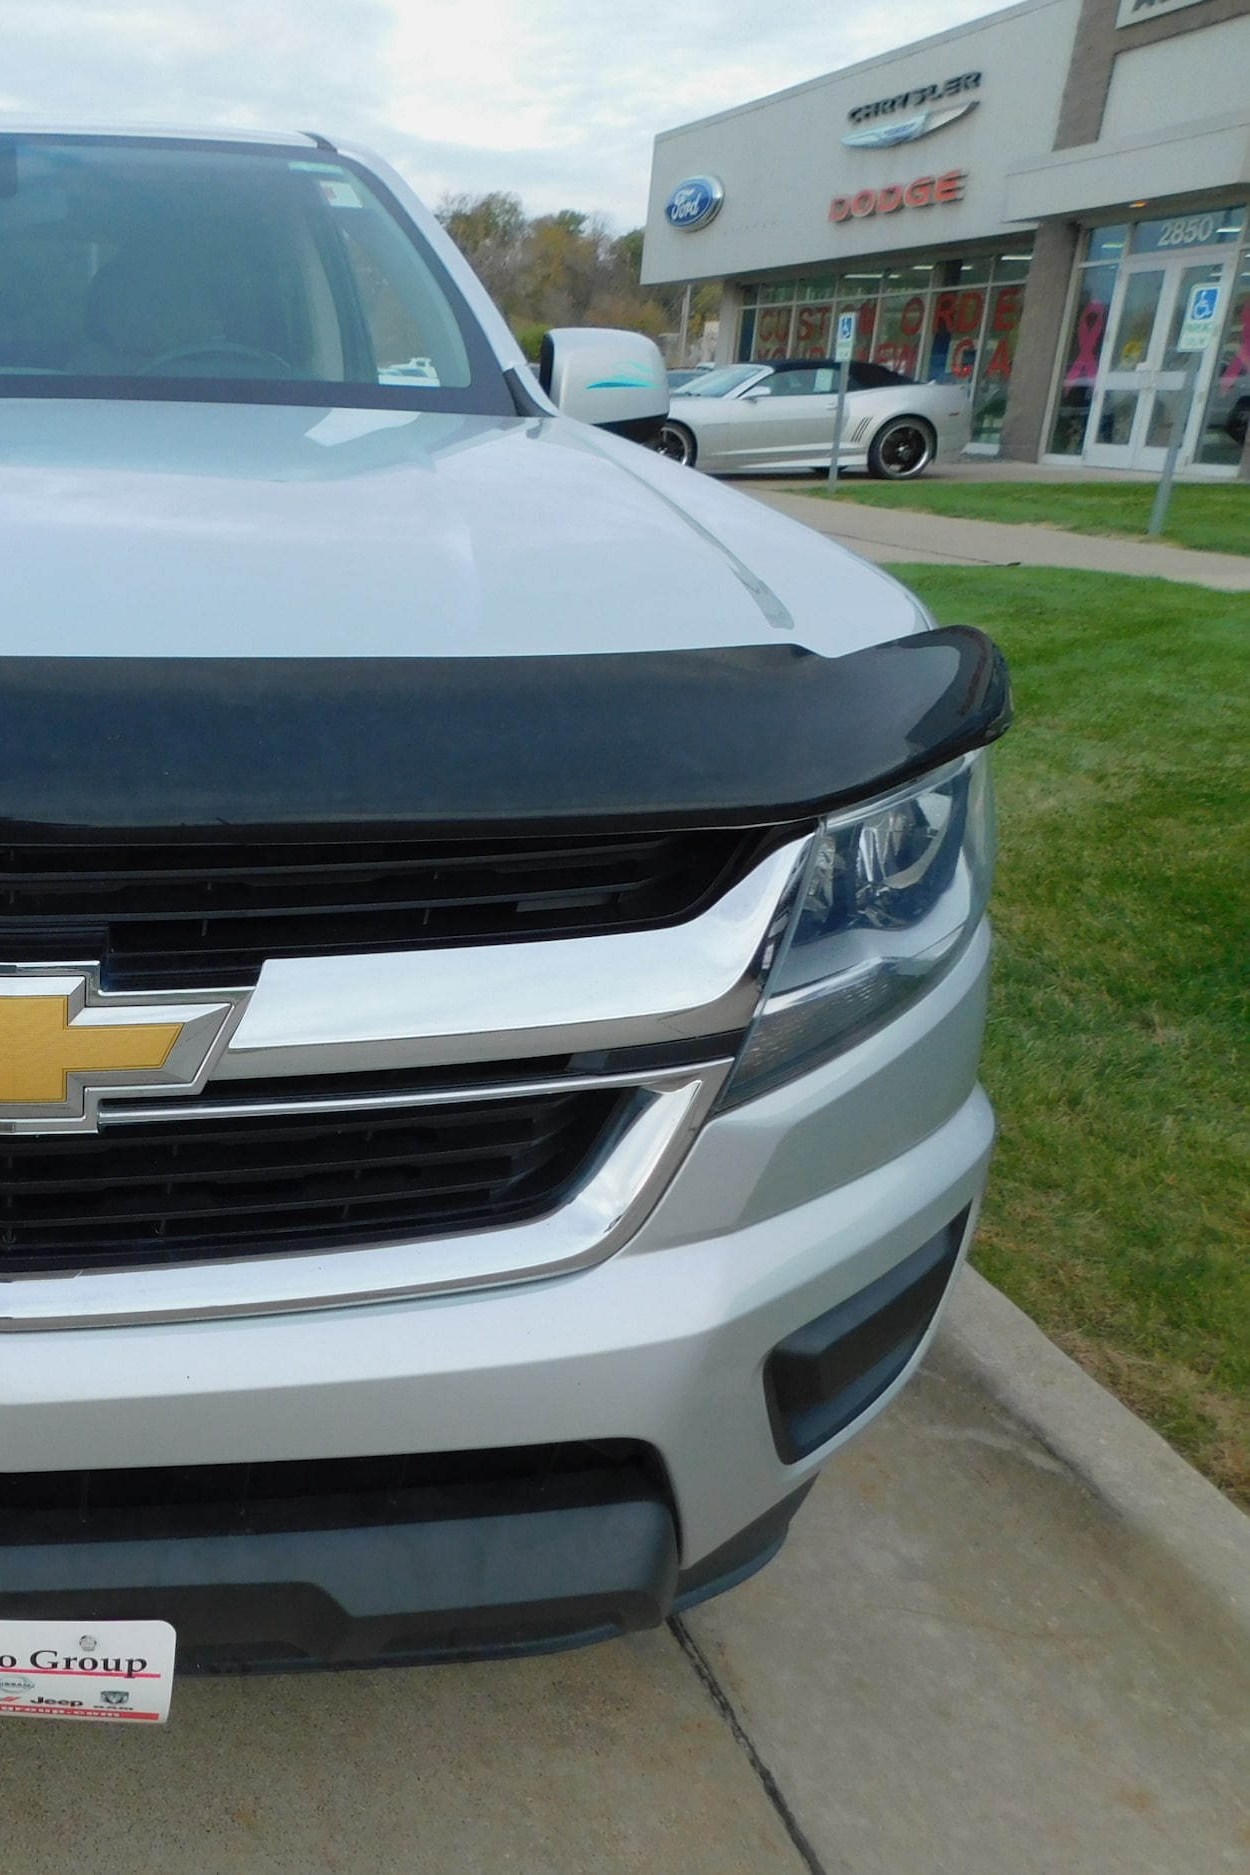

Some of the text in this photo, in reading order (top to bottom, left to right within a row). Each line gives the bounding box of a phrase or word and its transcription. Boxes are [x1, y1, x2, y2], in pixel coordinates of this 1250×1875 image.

[848, 72, 982, 124] CHRYSLER
[671, 188, 702, 220] Ford
[829, 169, 968, 223] DODGE
[1157, 215, 1214, 246] 2850
[759, 287, 1022, 342] CUSTM ORDE
[953, 337, 1011, 380] CA
[30, 1650, 148, 1679] Group
[30, 1697, 83, 1707] Jeep
